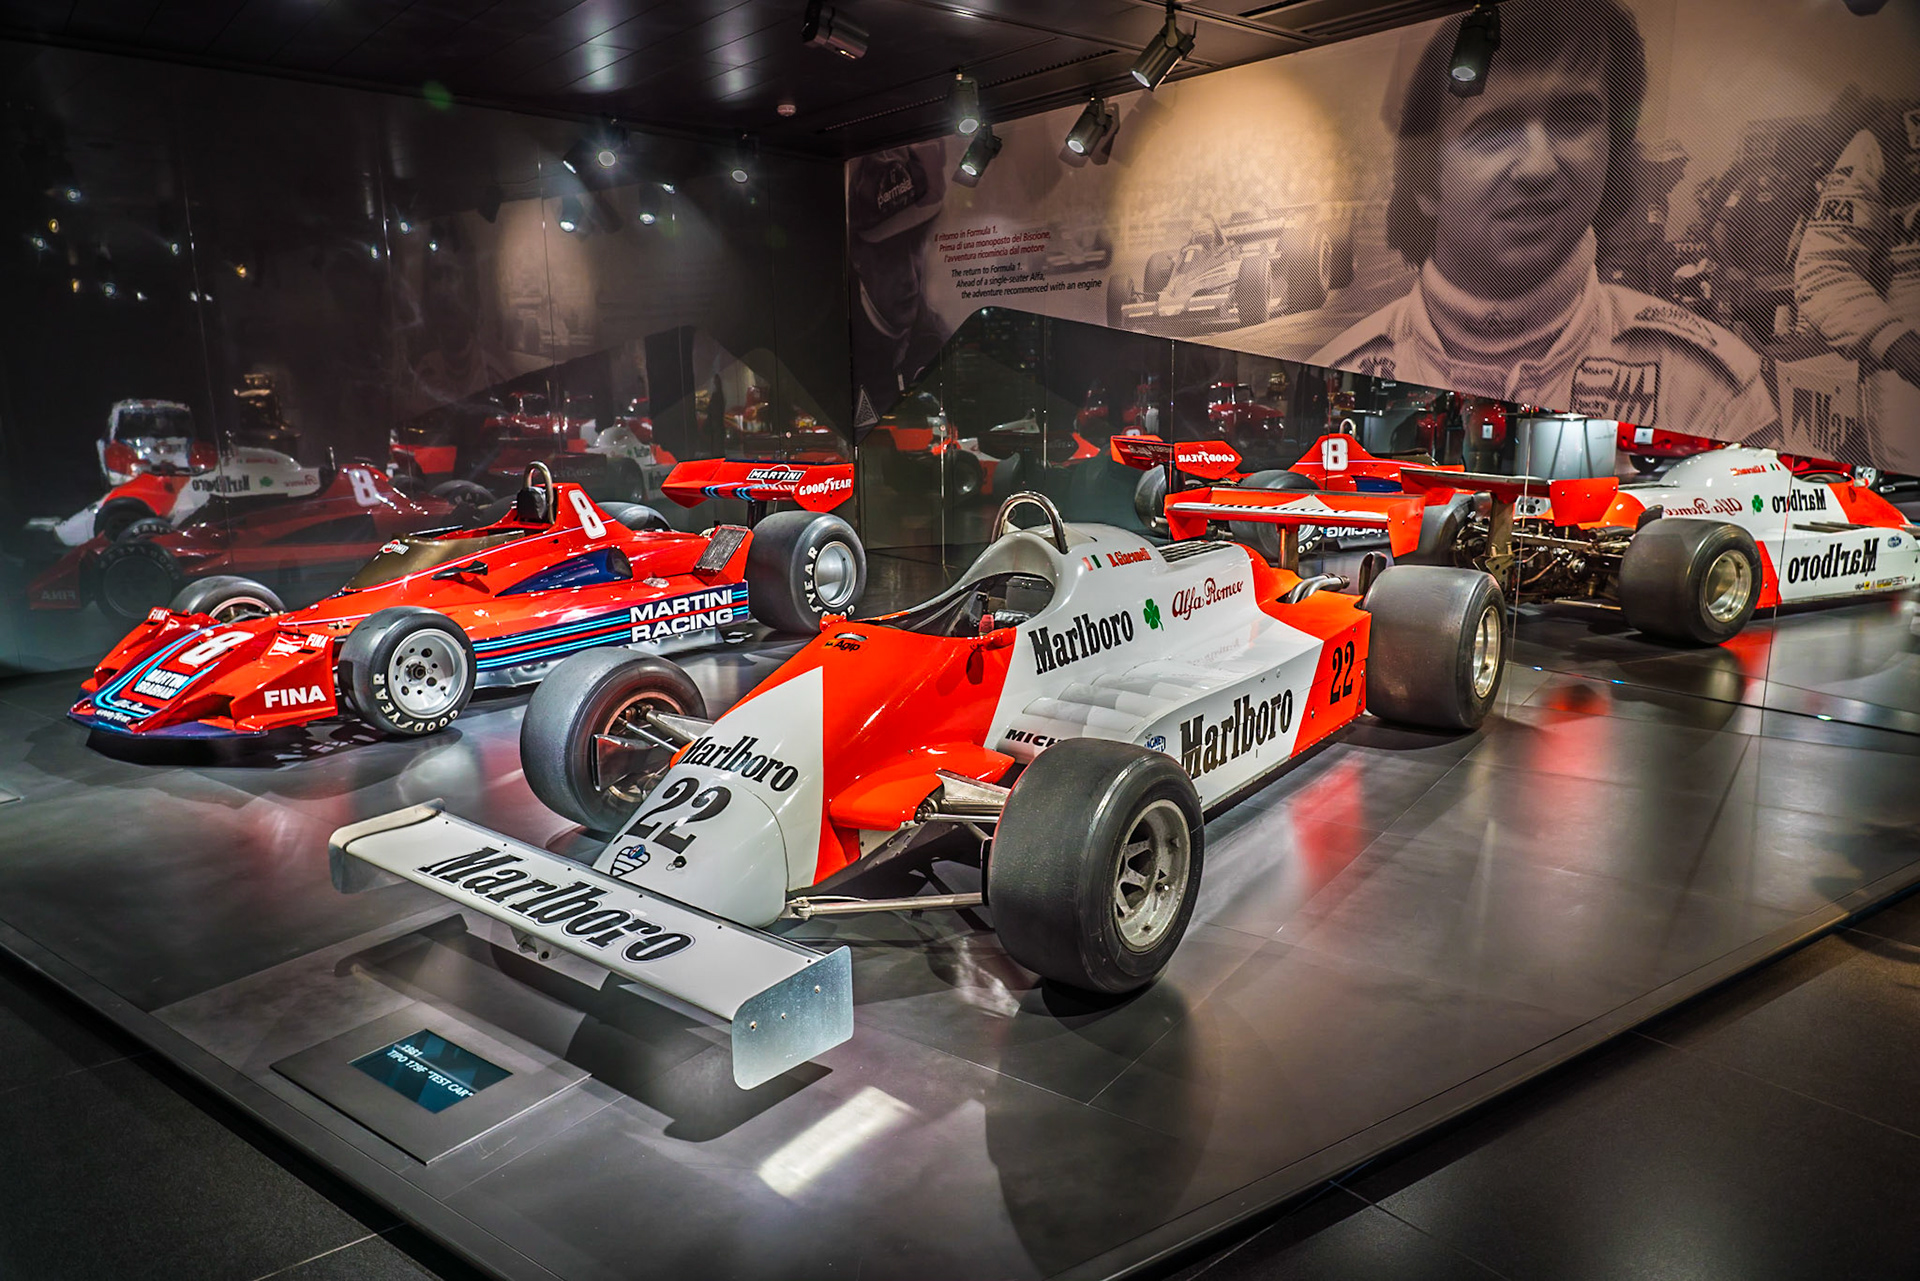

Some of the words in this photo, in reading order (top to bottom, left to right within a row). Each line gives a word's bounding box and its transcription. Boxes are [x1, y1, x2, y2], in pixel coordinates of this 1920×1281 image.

[939, 231, 959, 241] ritorno
[960, 230, 966, 239] in
[967, 226, 990, 237] Formula
[992, 225, 998, 234] 1.
[939, 243, 956, 252] Prima
[956, 241, 962, 250] di
[963, 241, 975, 249] una
[976, 236, 1010, 247] monoposto
[1012, 232, 1021, 243] del
[1023, 231, 1051, 242] Biscione,
[944, 252, 976, 262] l'avventura
[978, 246, 1008, 258] ricomincia
[1009, 245, 1020, 255] dal
[1021, 244, 1045, 253] motore
[951, 269, 962, 277] The
[962, 266, 981, 276] return
[982, 266, 989, 274] to
[990, 263, 1015, 273] Formula
[1017, 262, 1023, 271] 1.
[956, 278, 975, 288] Ahead
[976, 277, 984, 286] of
[989, 274, 1029, 286] single-seater
[1029, 271, 1045, 282] Alfa,
[961, 290, 971, 299] the
[972, 287, 1003, 298] adventure
[1004, 283, 1049, 295] recommenced
[1050, 281, 1066, 291] with
[1067, 282, 1076, 290] an
[1077, 279, 1102, 290] engine
[751, 470, 802, 480] MARTINI
[799, 477, 852, 495] GOODYEAR
[568, 489, 607, 540] 8
[630, 588, 733, 623] MARTINI
[1172, 587, 1205, 621] Alfa
[1202, 577, 1244, 606] Romeo
[631, 608, 734, 643] RACING
[178, 631, 255, 668] 8
[306, 633, 329, 648] FINA
[834, 640, 861, 652] Agip
[1028, 610, 1134, 675] Marlboro
[1329, 640, 1355, 705] 22
[264, 685, 327, 708] FINA
[1180, 689, 1293, 780] Marlboro
[678, 735, 799, 792] Marlboro
[622, 777, 731, 855] 22
[418, 846, 692, 962] Marlboro
[387, 1049, 408, 1063] TIPO
[405, 1060, 428, 1073] 179F
